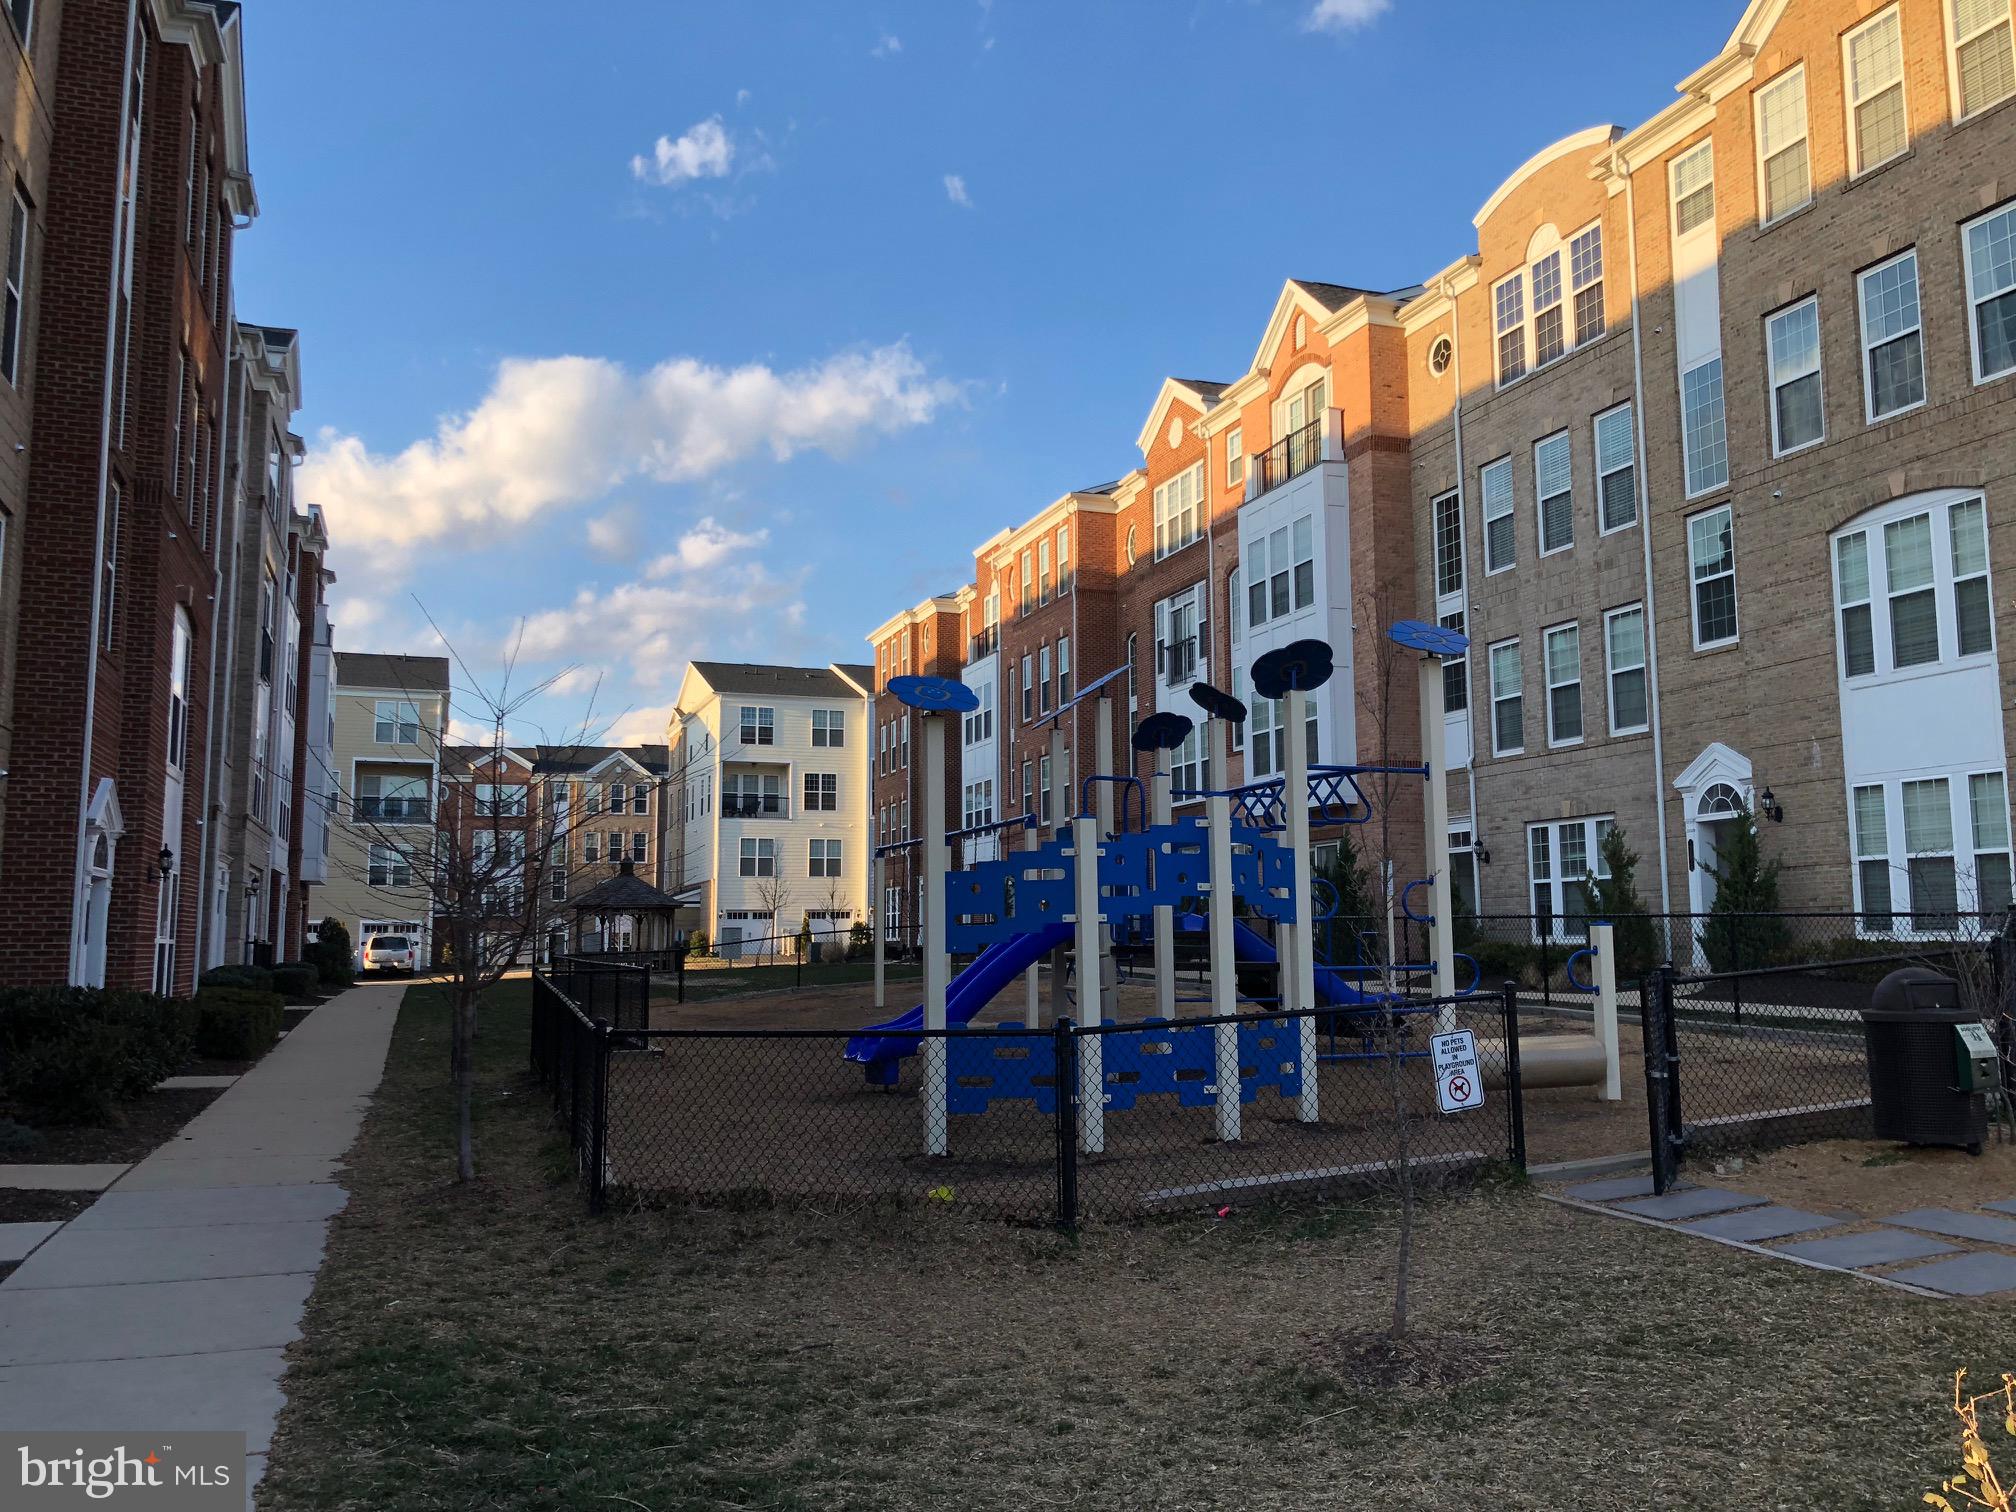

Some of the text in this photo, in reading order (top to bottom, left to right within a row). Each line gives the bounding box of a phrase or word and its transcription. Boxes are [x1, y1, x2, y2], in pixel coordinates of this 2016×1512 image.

[1450, 1037, 1464, 1045] PETS
[1441, 1045, 1467, 1055] ALLOWED
[1438, 1059, 1474, 1071] PLAYGROUND
[1450, 1068, 1465, 1076] AREA
